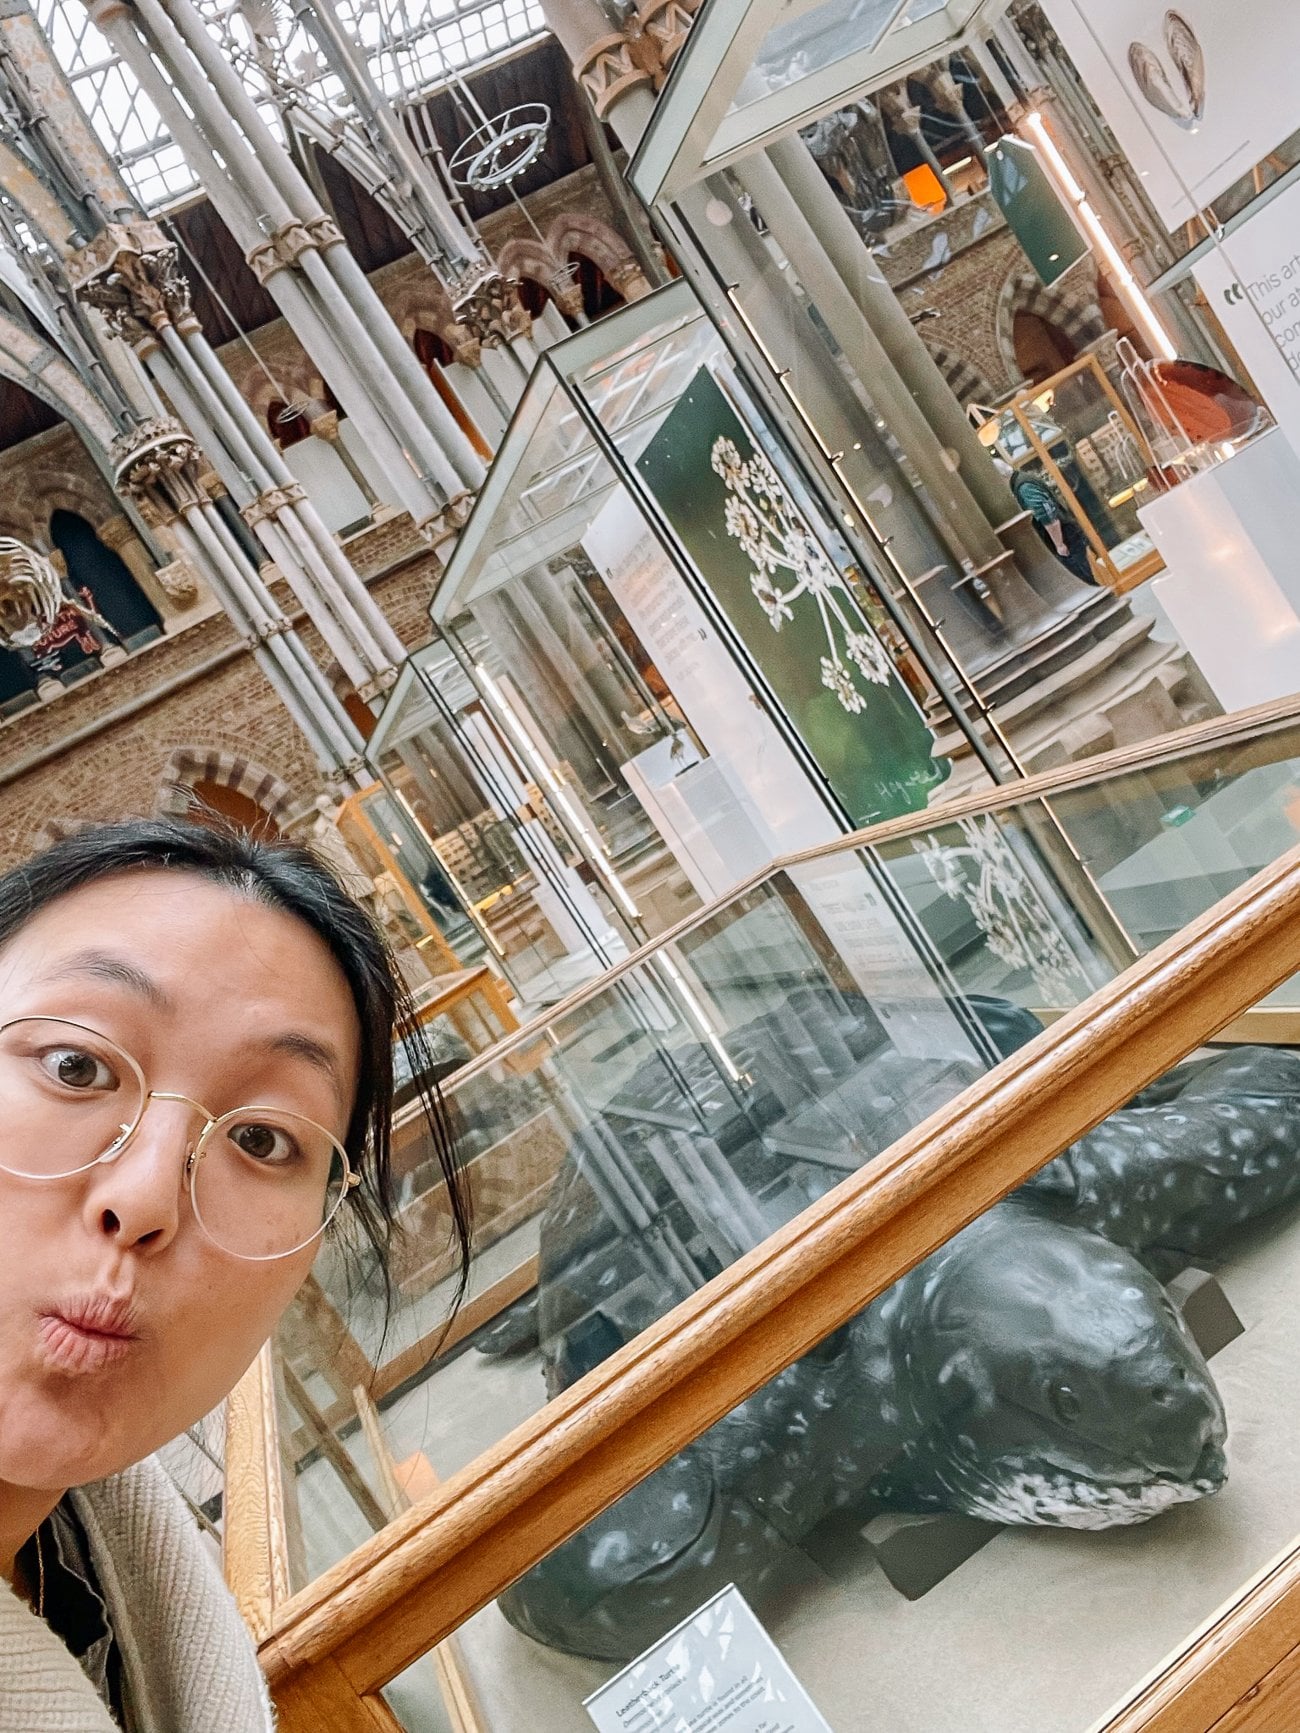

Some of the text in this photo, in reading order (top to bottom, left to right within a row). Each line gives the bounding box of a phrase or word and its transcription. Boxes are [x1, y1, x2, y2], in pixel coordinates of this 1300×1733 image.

[1245, 272, 1282, 302] This
[1262, 300, 1287, 325] our
[658, 1663, 681, 1682] Turte
